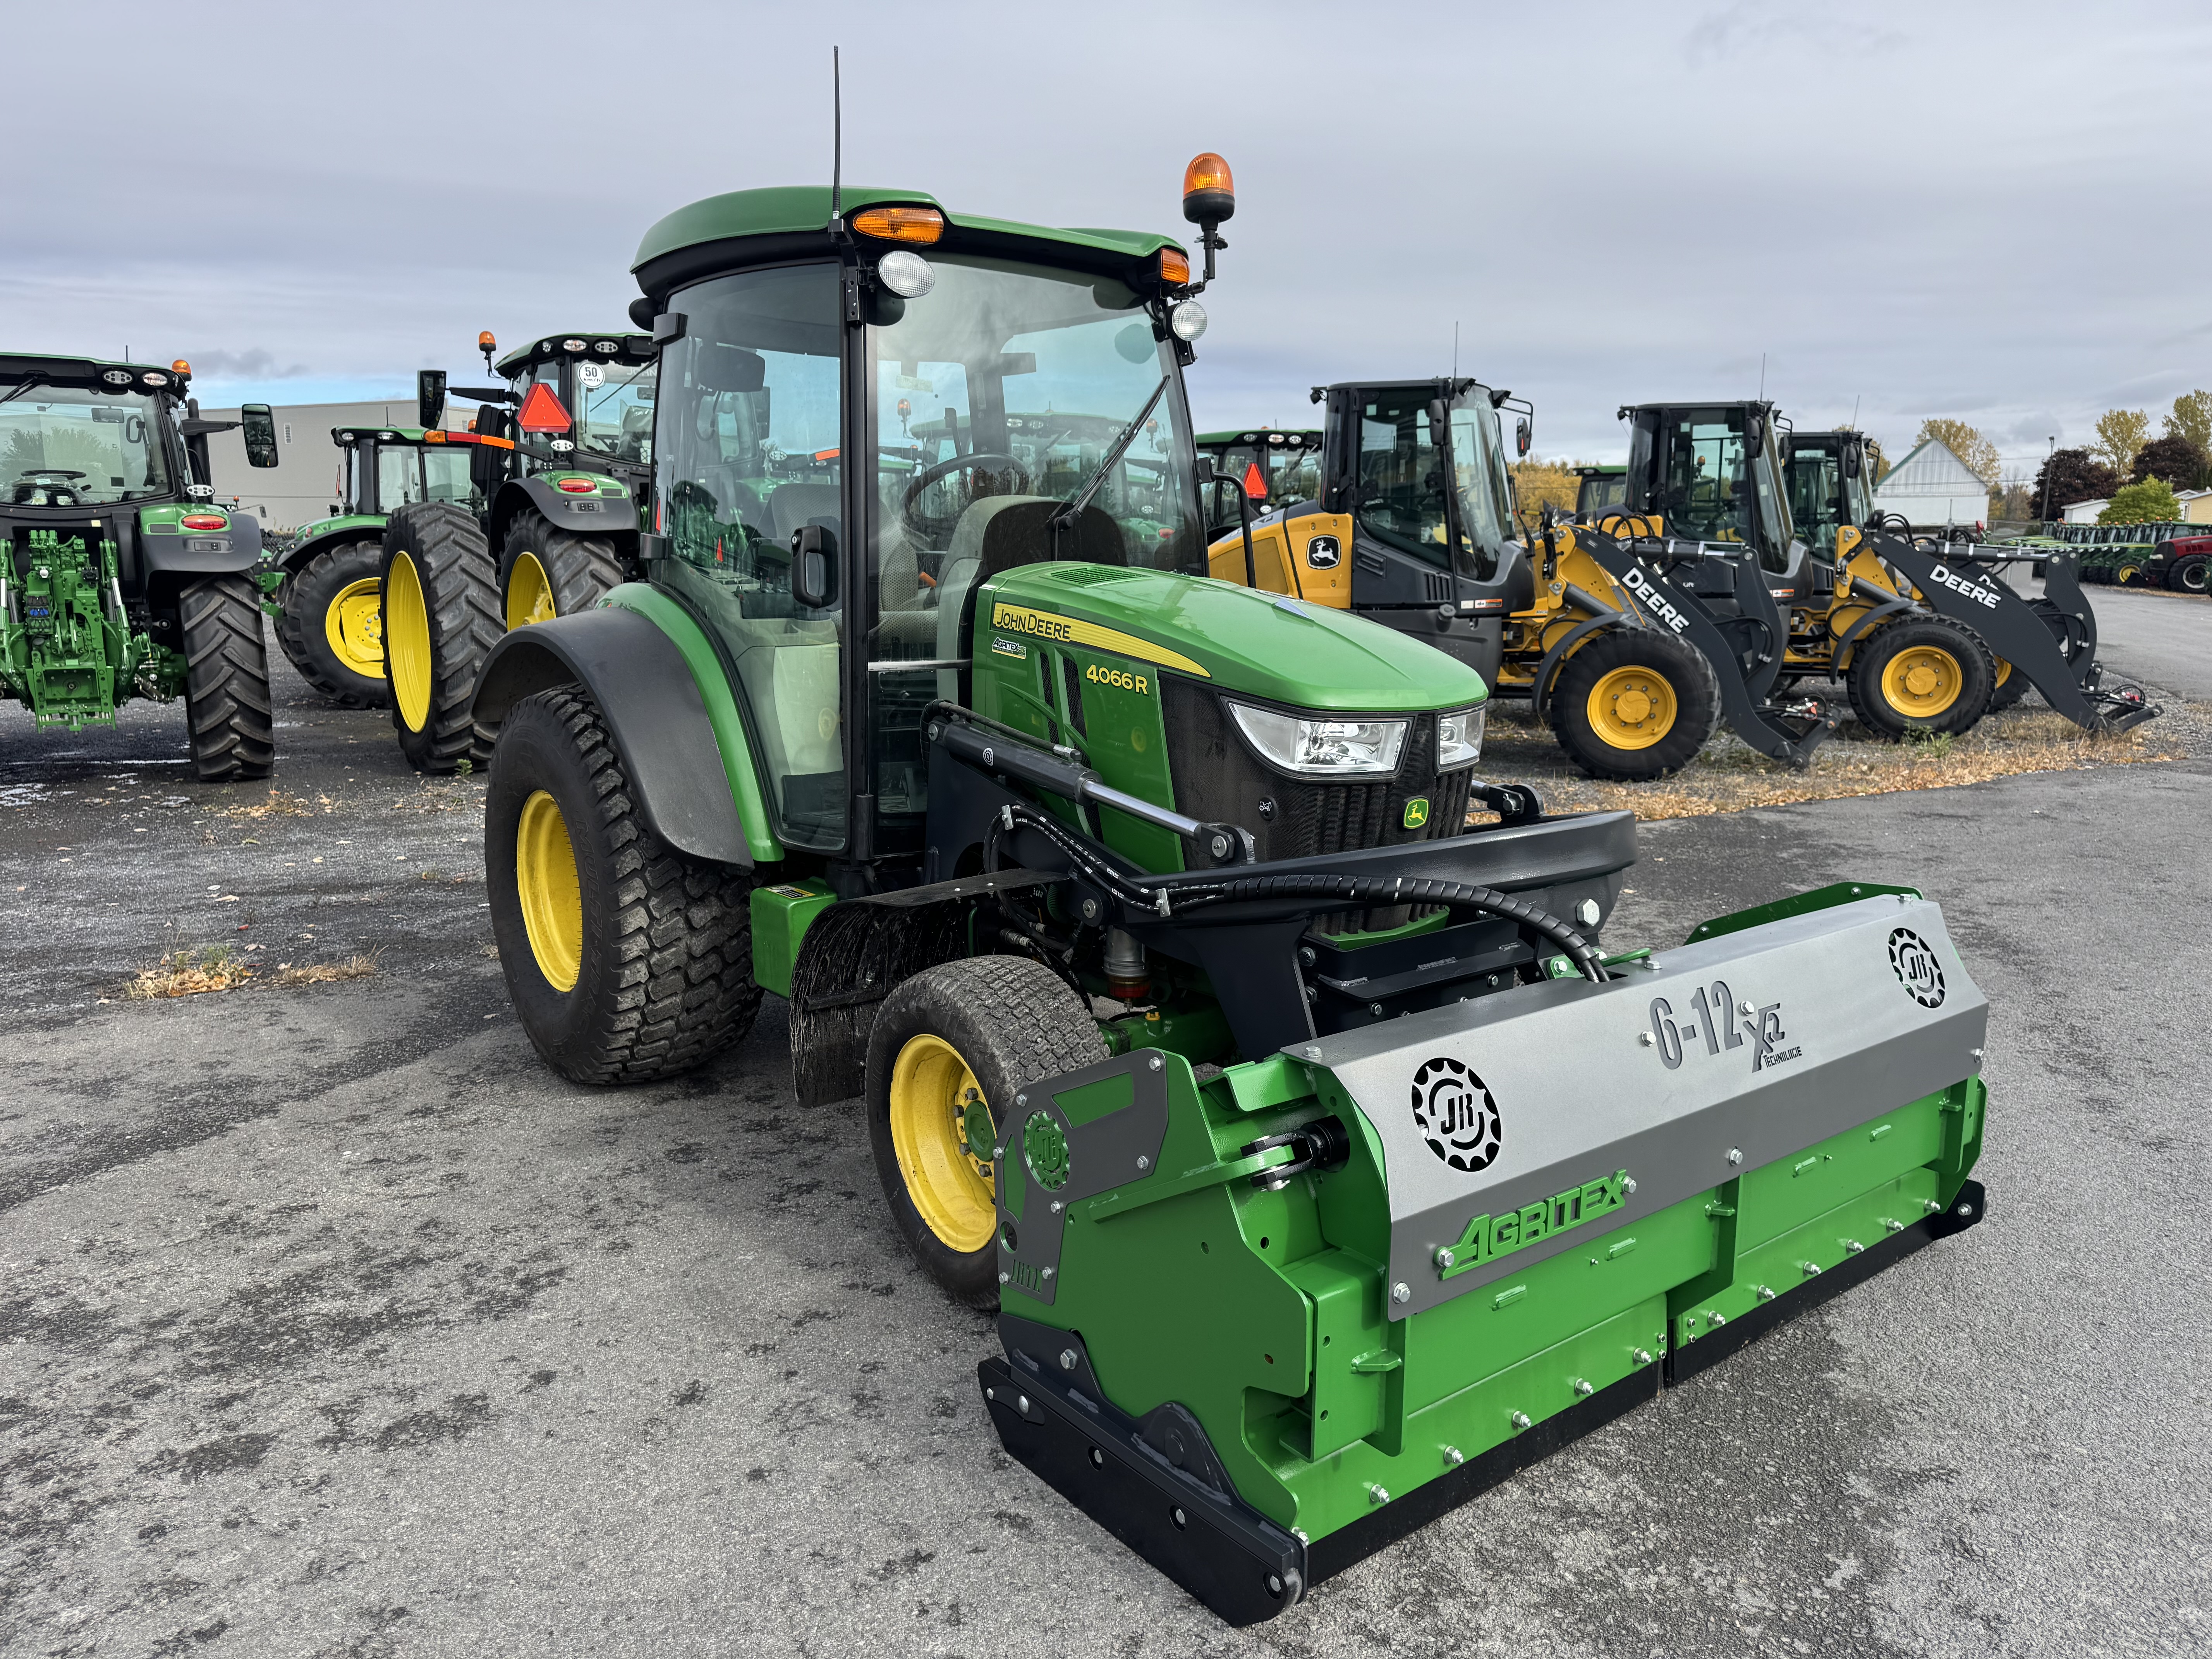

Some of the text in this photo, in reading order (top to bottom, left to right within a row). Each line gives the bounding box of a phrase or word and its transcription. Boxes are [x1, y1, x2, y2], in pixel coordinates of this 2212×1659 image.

[585, 367, 598, 377] 50
[1622, 567, 1690, 634] DEERE
[1929, 564, 2001, 609] DEERE
[993, 638, 1019, 651] AGRITEX
[997, 608, 1071, 640] JOHN DEERE
[1649, 981, 1743, 1070] 6-12
[1438, 1168, 1628, 1281] AGRITEX
